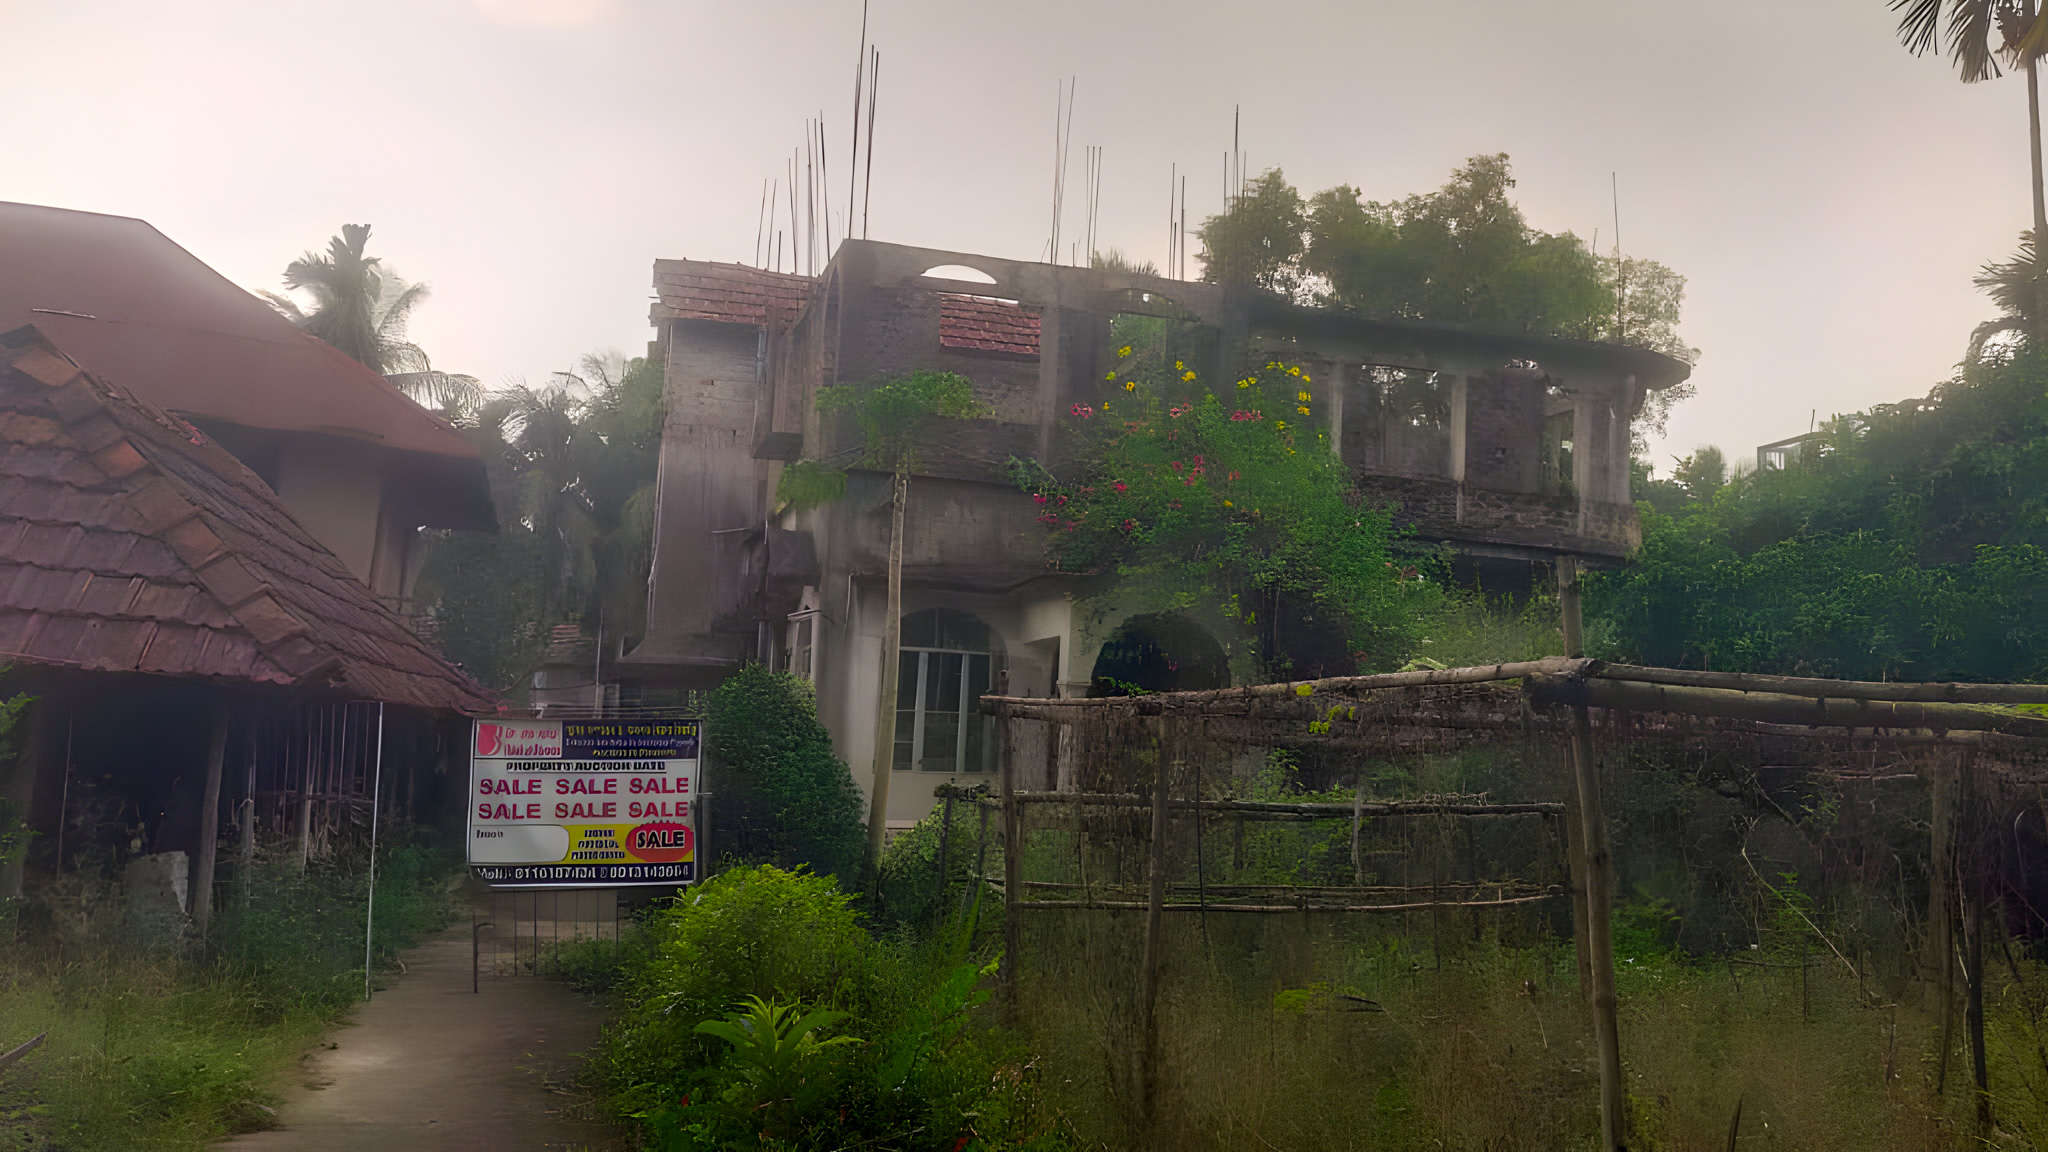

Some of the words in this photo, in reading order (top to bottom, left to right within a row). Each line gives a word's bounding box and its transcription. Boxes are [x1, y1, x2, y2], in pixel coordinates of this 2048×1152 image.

[479, 779, 542, 795] SALE
[555, 778, 618, 794] SALE
[629, 777, 689, 794] SALE
[478, 803, 541, 819] SALE
[555, 802, 617, 818] SALE
[628, 801, 689, 818] SALE
[636, 830, 685, 849] SALE
